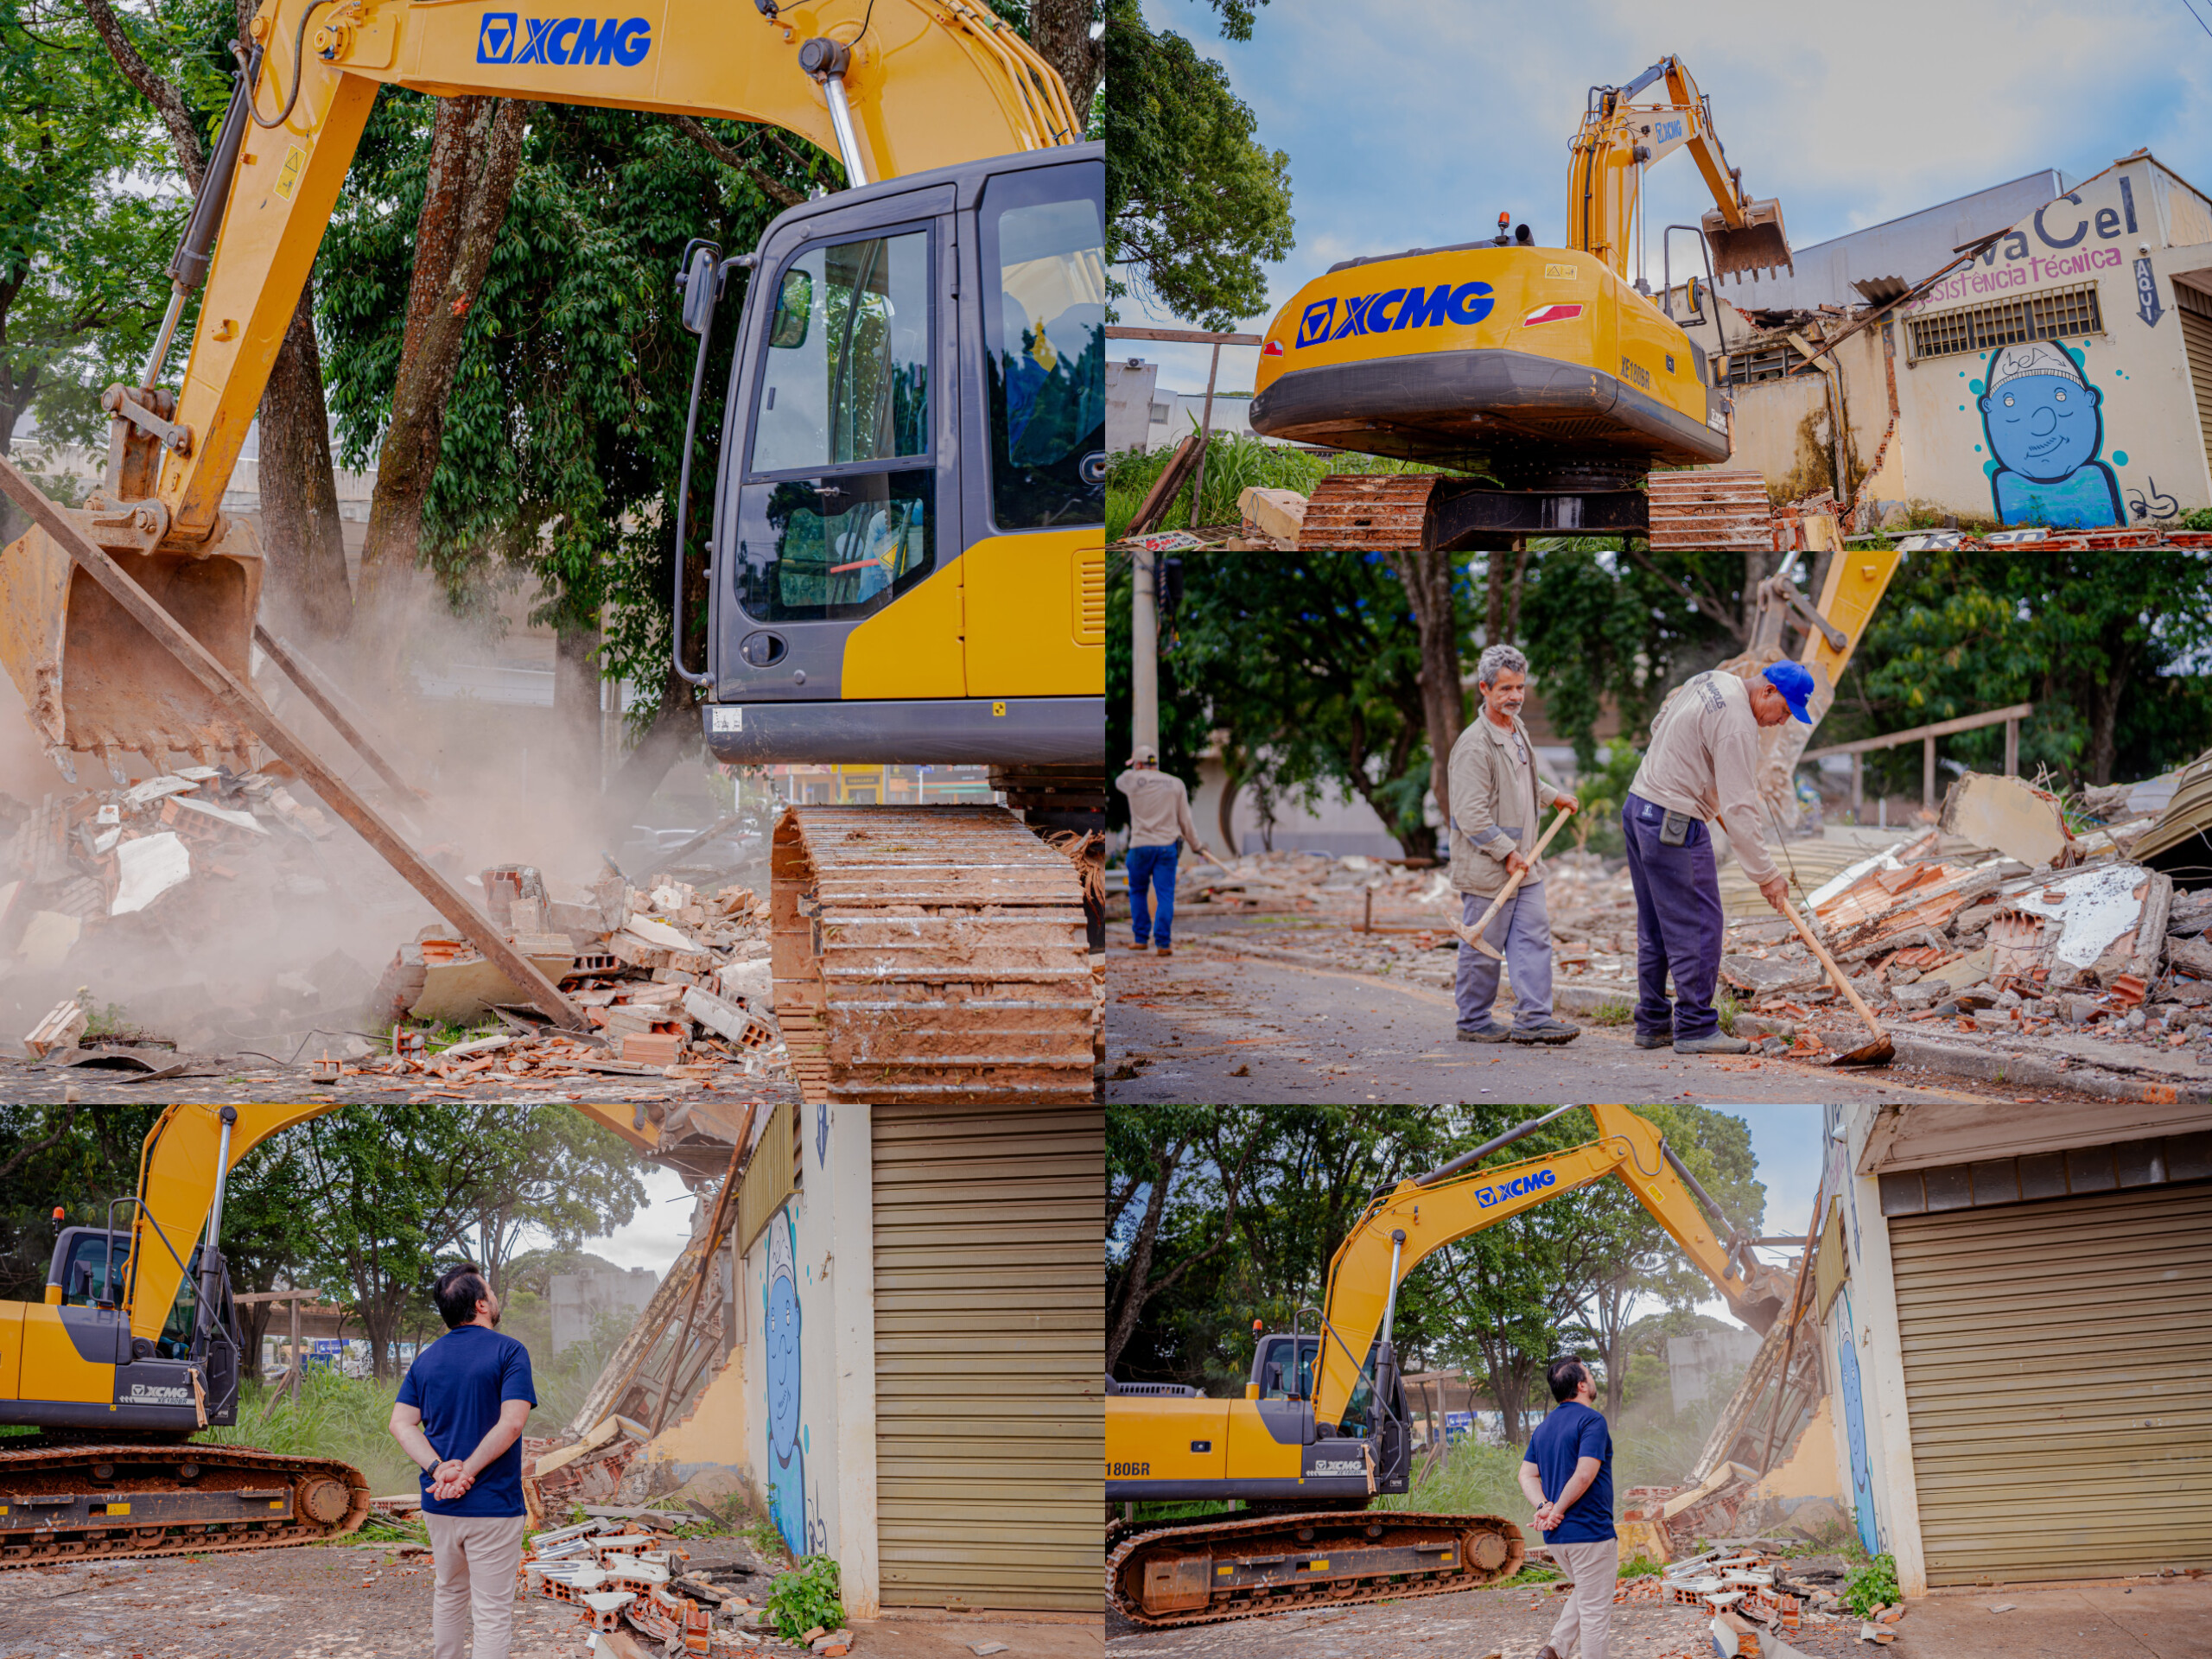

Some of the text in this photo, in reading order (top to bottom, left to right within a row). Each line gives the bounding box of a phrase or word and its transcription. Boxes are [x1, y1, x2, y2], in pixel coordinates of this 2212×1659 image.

[512, 17, 652, 67] XCMG
[2136, 260, 2154, 321] AQUI
[1328, 281, 1495, 340] XCMG
[1496, 1169, 1556, 1203] XCMG
[146, 1386, 188, 1398] XCMG
[1105, 1462, 1150, 1476] 180BR
[1327, 1460, 1363, 1471] XCMG
